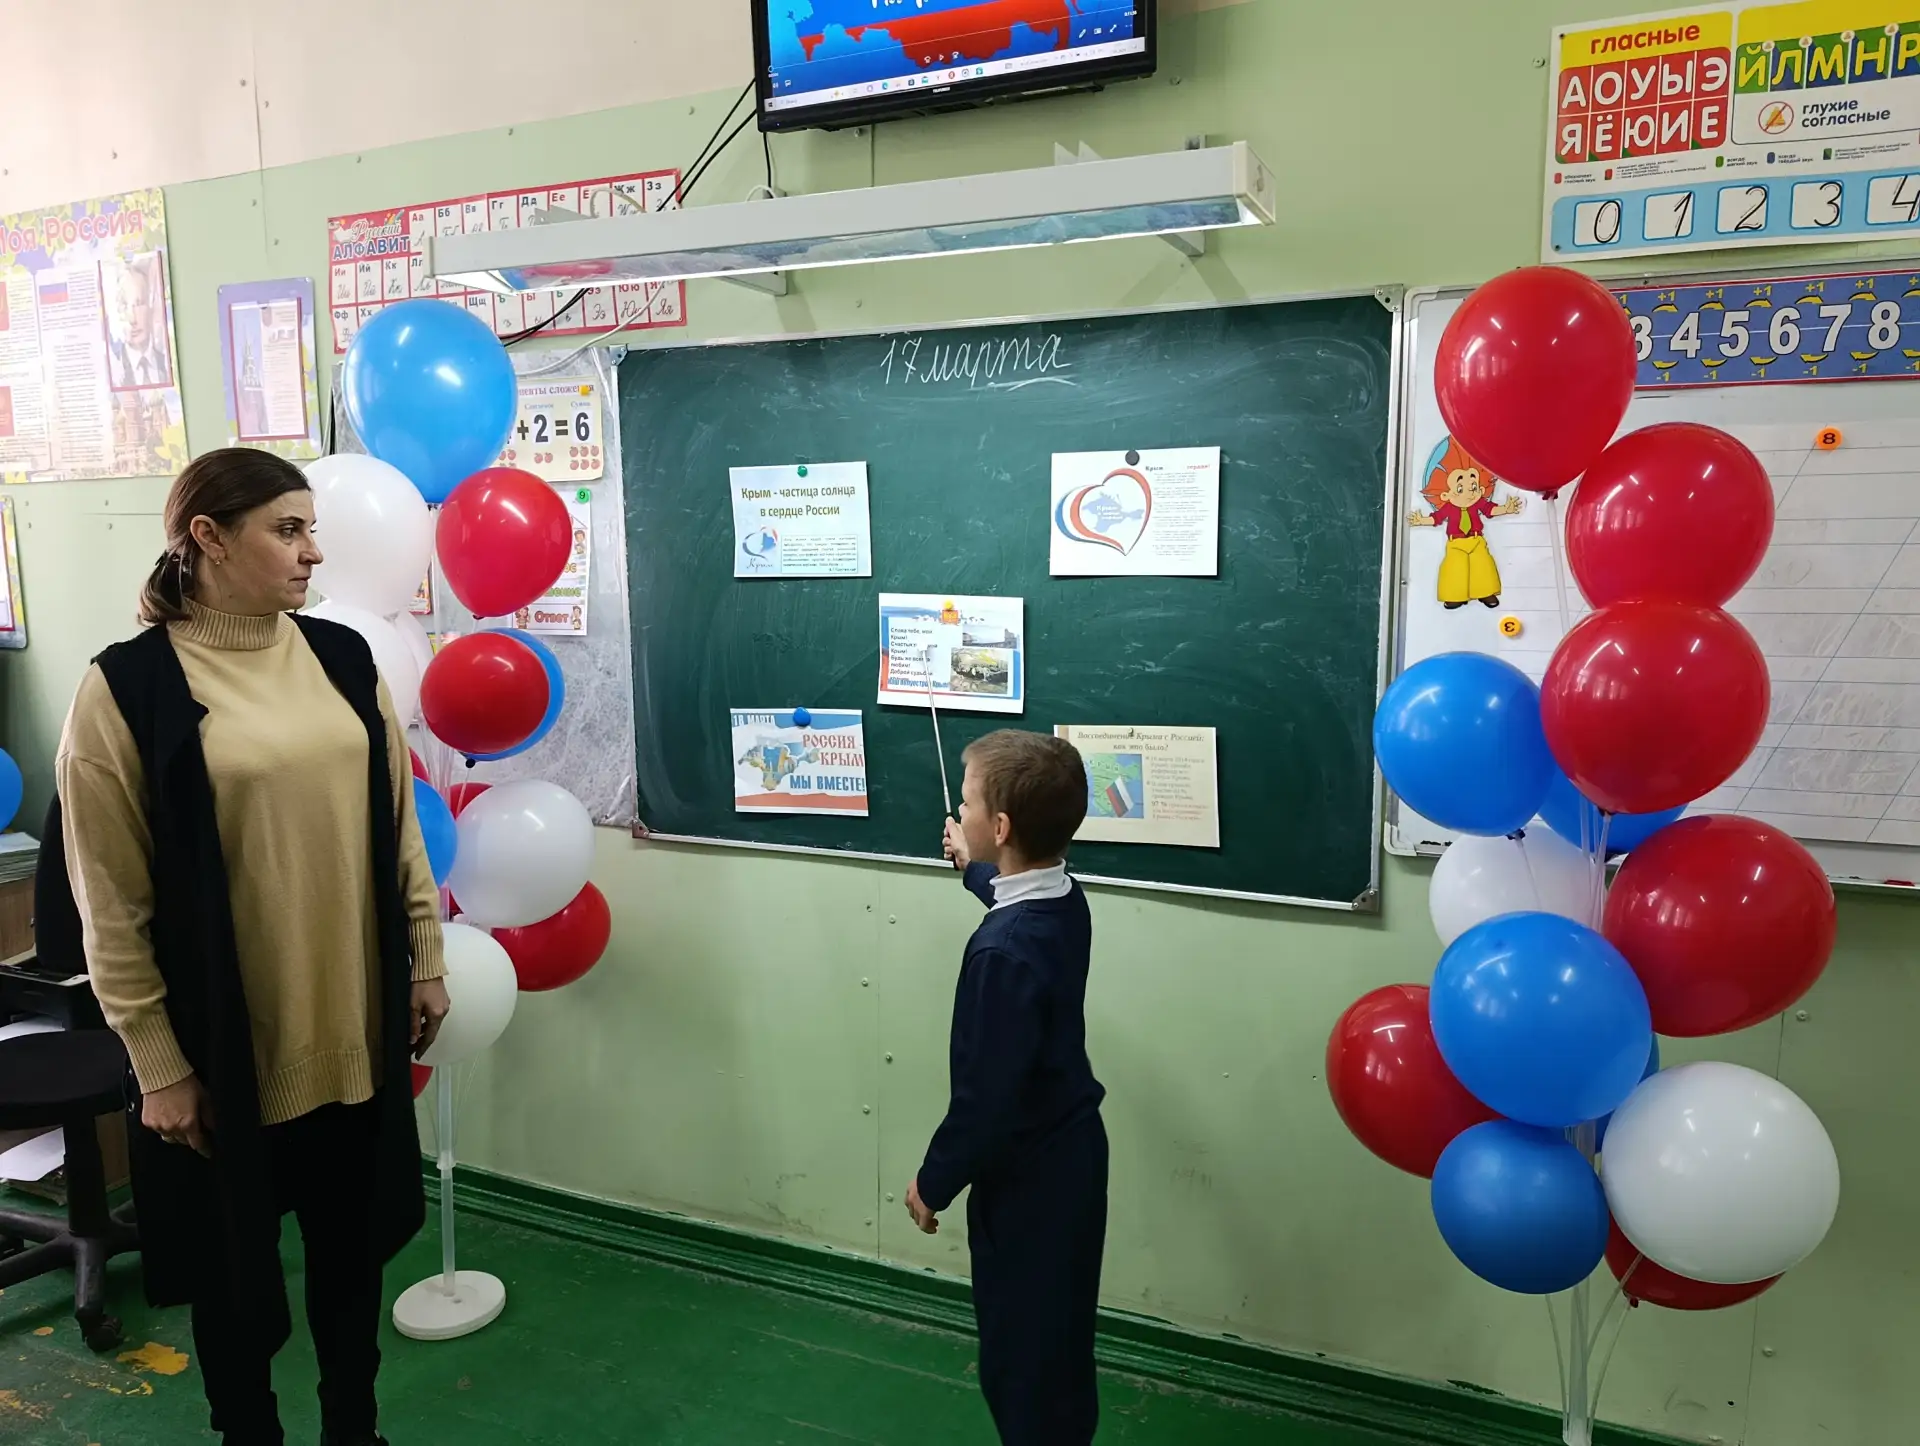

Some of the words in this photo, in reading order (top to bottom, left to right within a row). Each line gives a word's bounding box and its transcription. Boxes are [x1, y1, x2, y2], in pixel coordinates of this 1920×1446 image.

[1590, 25, 1700, 55] гласные
[1771, 50, 1802, 86] Л
[1808, 49, 1844, 83] М
[1854, 41, 1886, 77] Н
[1662, 61, 1692, 95] Ы
[1701, 57, 1727, 92] Э
[1801, 108, 1891, 128] согласные
[1802, 97, 1858, 116] глухие
[1560, 123, 1582, 156] Я
[1595, 114, 1613, 153] Ё
[1624, 114, 1656, 149] Ю
[1662, 110, 1688, 145] И
[1701, 105, 1720, 139] Е
[412, 213, 424, 222] Аа
[438, 208, 450, 217] Бб
[466, 204, 476, 213] Вв
[492, 201, 504, 209] Гг
[521, 197, 537, 207] Дд
[552, 193, 566, 202] Ее
[647, 182, 662, 191] Зз
[1593, 200, 1621, 244] 0
[1674, 191, 1692, 237] 1
[1734, 185, 1768, 231] 2
[1814, 182, 1842, 227] 3
[1891, 175, 1920, 222] 4
[44, 210, 143, 247] Россия
[334, 236, 409, 260] АЛФАВИТ
[385, 261, 397, 269] Кк
[1657, 291, 1676, 302] +1
[1705, 288, 1723, 299] +1
[1753, 285, 1772, 297] +1
[1805, 281, 1825, 293] +1
[1855, 278, 1874, 290] +1
[334, 311, 348, 320] Фф
[469, 298, 486, 306] Щщ
[1632, 315, 1653, 362] 3
[1669, 312, 1701, 359] 4
[1718, 310, 1750, 358] 5
[1768, 307, 1801, 355] 6
[1819, 304, 1852, 353] 7
[1867, 300, 1901, 351] 8
[880, 337, 922, 384] 17
[921, 334, 1072, 388] марта
[549, 384, 594, 394] сложея
[534, 414, 548, 442] 2
[576, 412, 589, 441] 6
[1823, 433, 1835, 444] 8
[742, 488, 771, 501] Крым
[780, 488, 818, 498] частица
[821, 486, 855, 496] солнца
[768, 508, 803, 519] сердце
[806, 505, 840, 515] России
[803, 734, 855, 748] РОССИЯ
[821, 752, 864, 766] КРЫМ
[790, 776, 811, 789] МЫ
[817, 776, 865, 791] ВМЕСТЕ!
